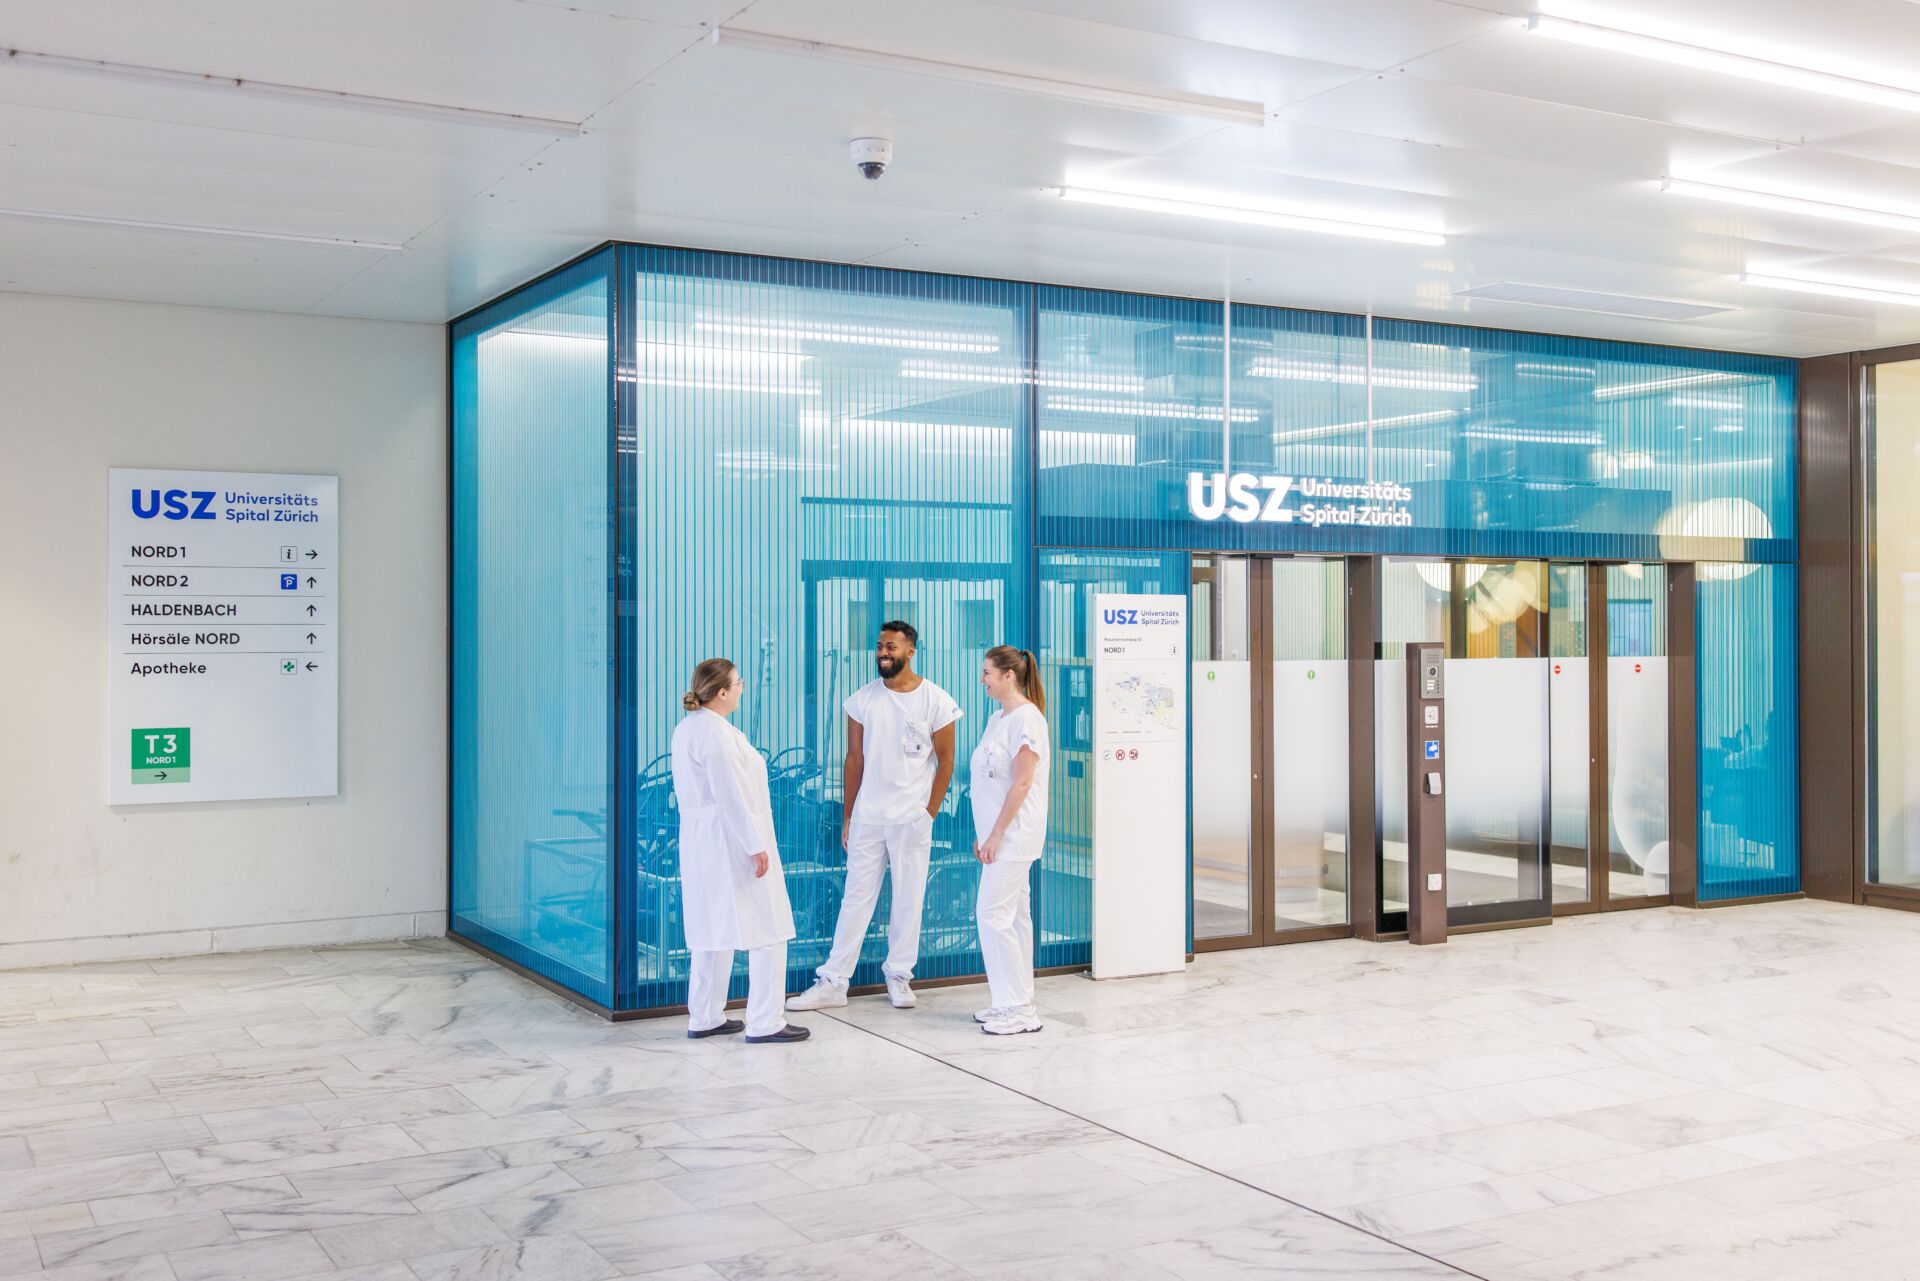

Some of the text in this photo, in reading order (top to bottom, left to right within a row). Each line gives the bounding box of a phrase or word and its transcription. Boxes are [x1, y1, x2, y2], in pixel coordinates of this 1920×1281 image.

[1301, 477, 1412, 501] Universitäts
[131, 489, 216, 520] USZ
[225, 491, 318, 506] Universitäts
[1189, 472, 1293, 523] USZ
[225, 508, 319, 523] Spital Zürich
[1301, 504, 1412, 527] Spital Zürich
[131, 604, 237, 616] HALDENBACH
[1104, 609, 1138, 625] USZ
[1141, 618, 1160, 626] Spital
[131, 632, 240, 645] Hörsäle NORD
[130, 662, 207, 677] Apotheke
